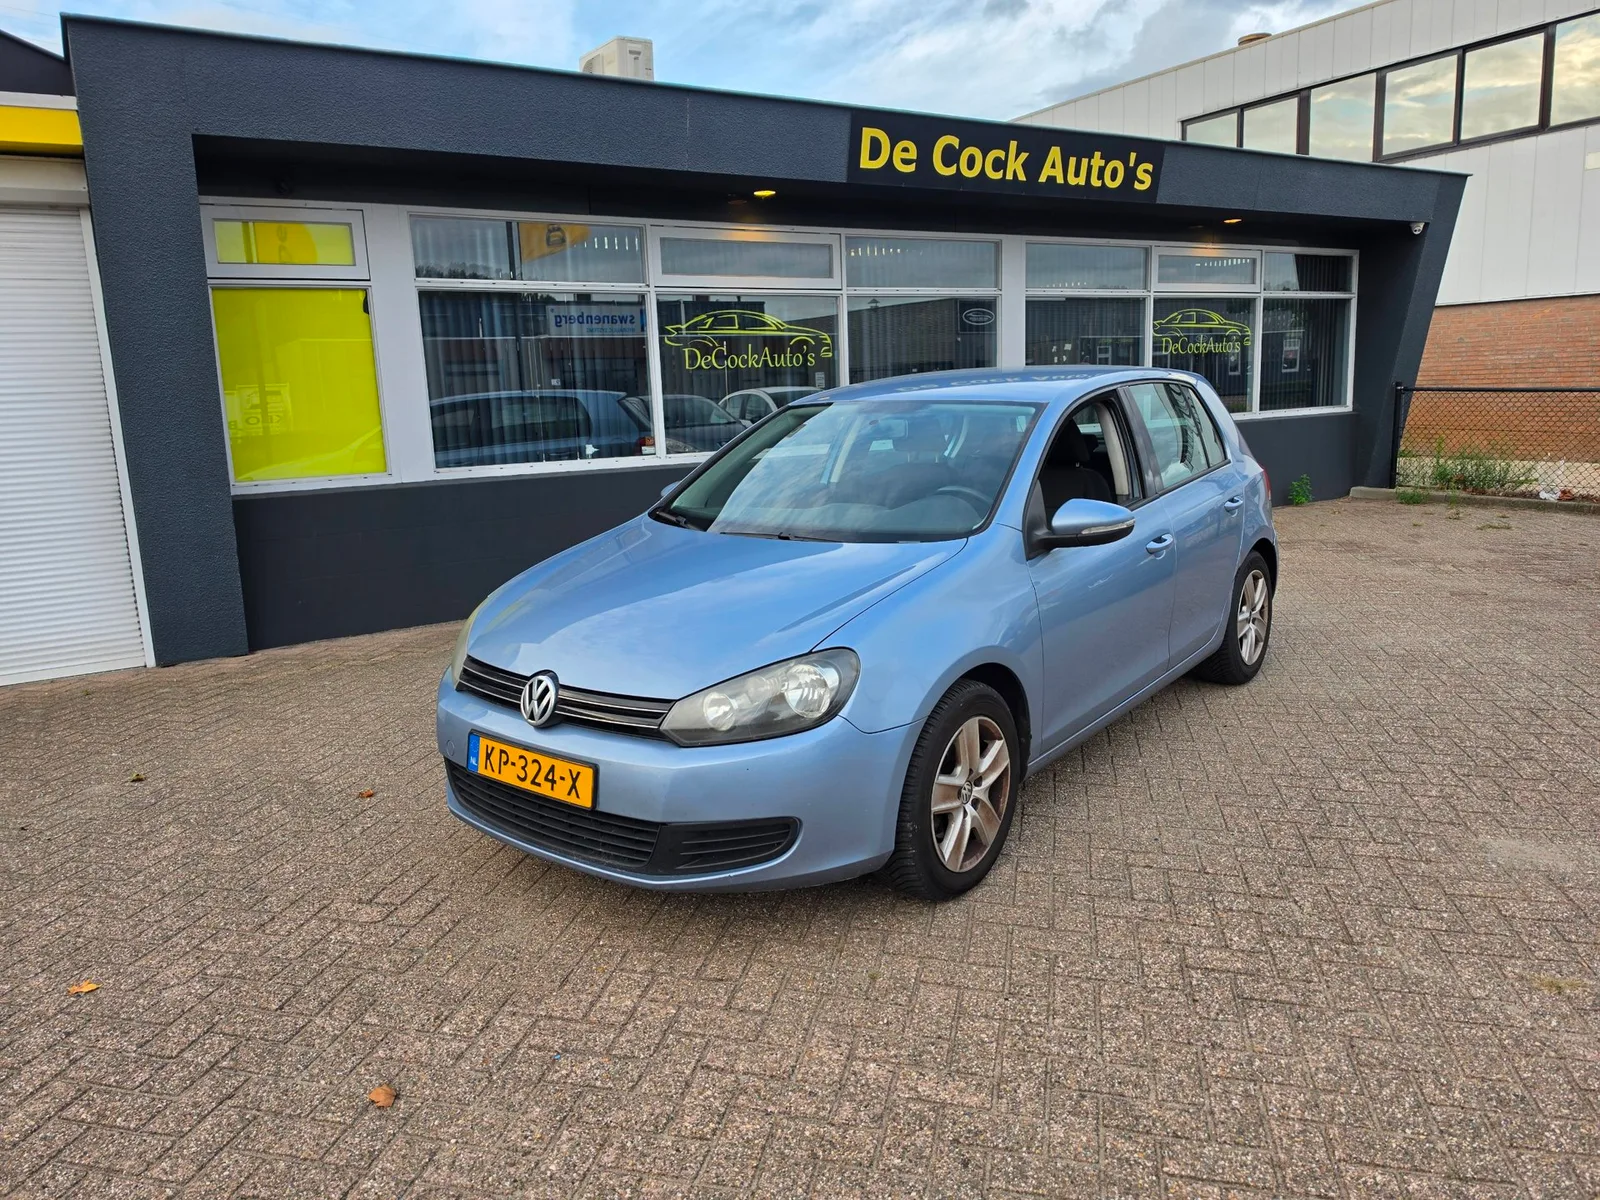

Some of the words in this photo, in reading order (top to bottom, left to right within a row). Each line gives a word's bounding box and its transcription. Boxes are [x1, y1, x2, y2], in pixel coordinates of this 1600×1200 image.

[859, 126, 918, 174] De
[932, 134, 1030, 182] Cock
[1038, 145, 1154, 191] Auto's
[682, 343, 816, 370] DeCockAuto's
[1161, 334, 1241, 355] DeCockAuto's
[484, 744, 582, 799] KP-324-X
